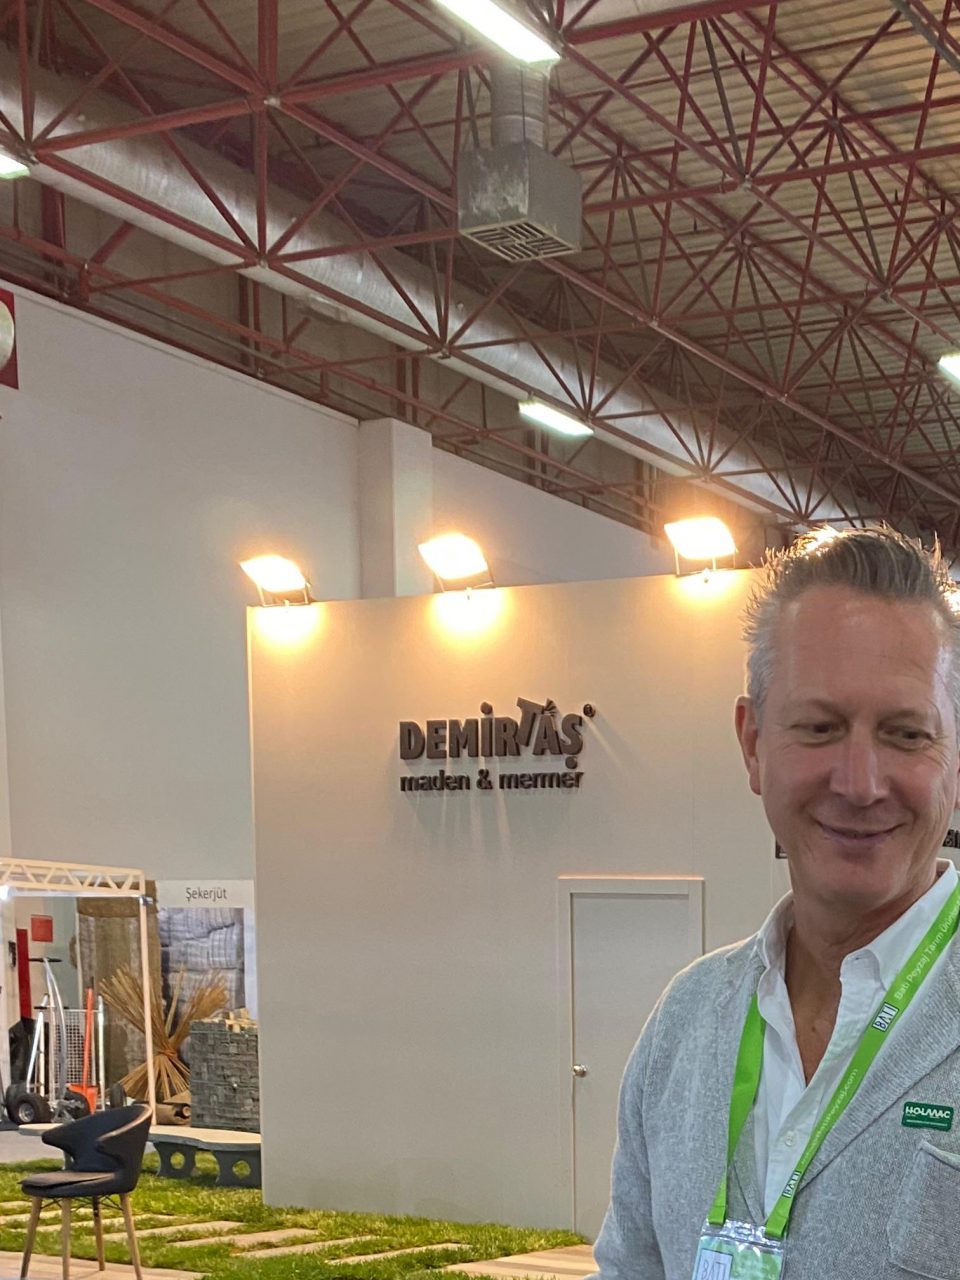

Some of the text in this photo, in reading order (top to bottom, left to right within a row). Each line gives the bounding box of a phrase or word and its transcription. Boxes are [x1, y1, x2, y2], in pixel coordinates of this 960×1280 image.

[400, 769, 584, 791] maden & mermer
